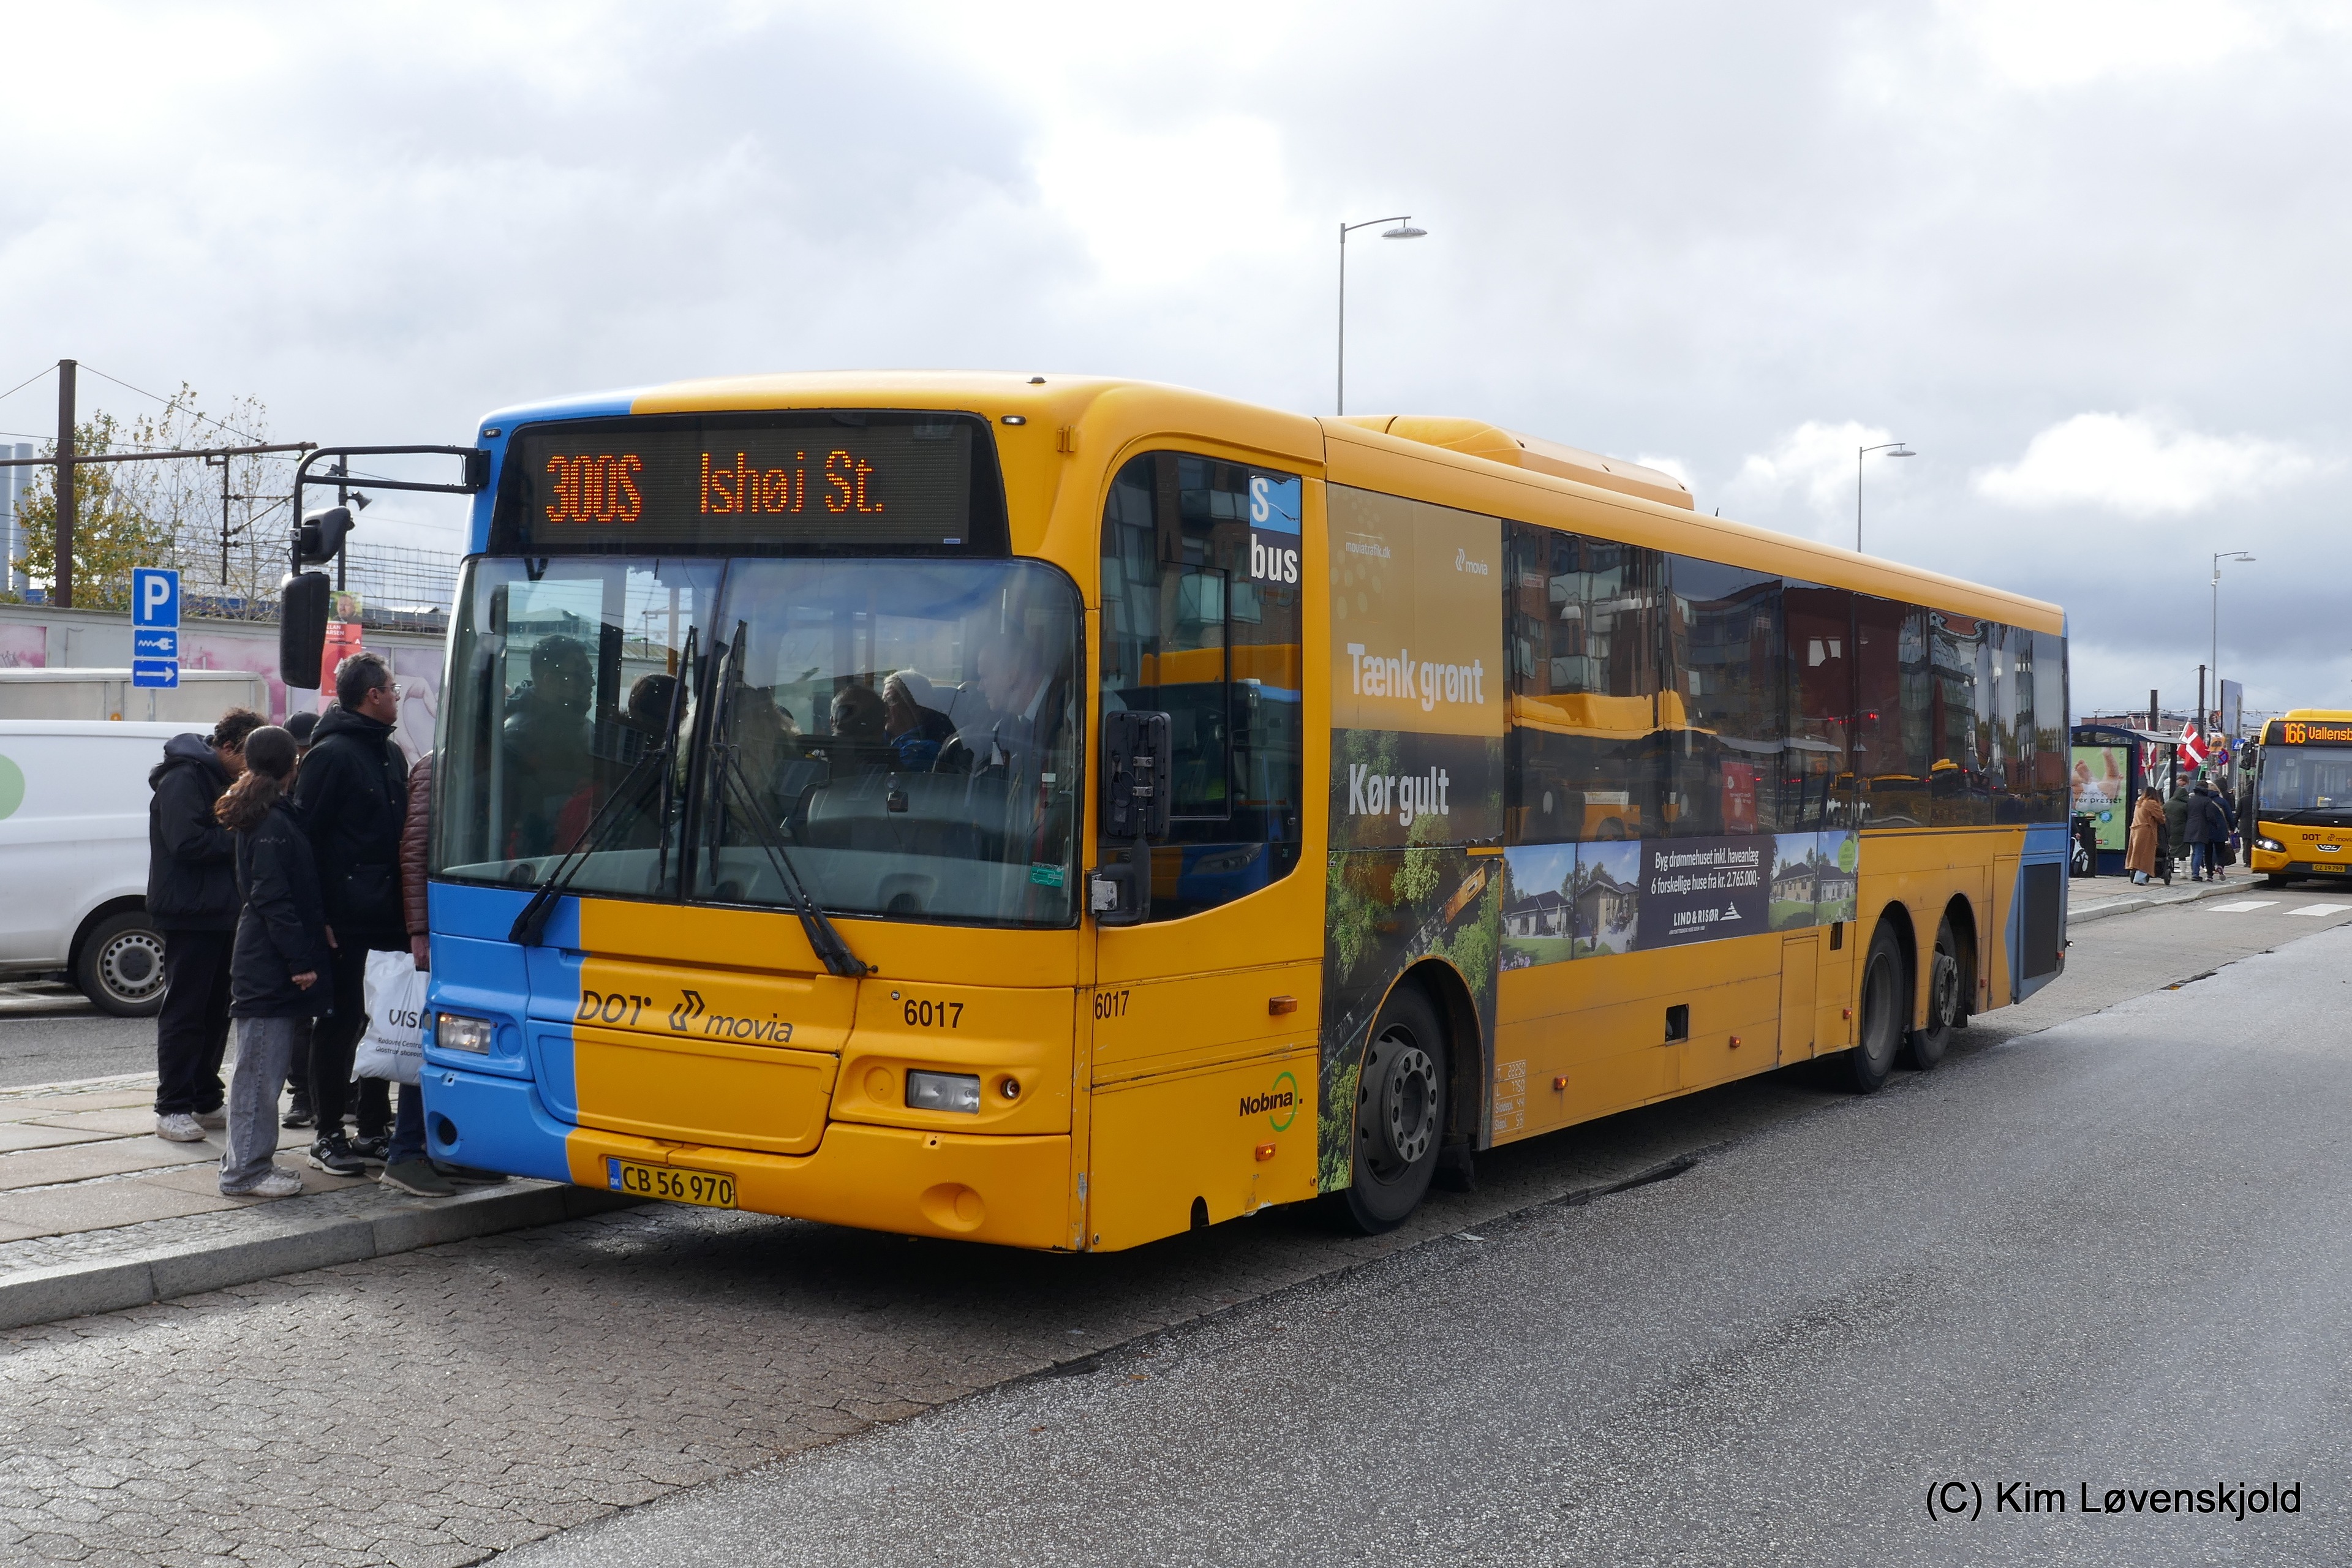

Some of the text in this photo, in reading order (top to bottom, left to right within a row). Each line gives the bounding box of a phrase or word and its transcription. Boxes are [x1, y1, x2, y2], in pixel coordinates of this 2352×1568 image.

[546, 450, 884, 522] 300S Ishøj St.
[1251, 477, 1269, 522] S
[1251, 533, 1298, 584] bus
[1346, 541, 1391, 559] moviatrafik.dk
[1466, 559, 1488, 575] movia
[144, 575, 170, 620] P
[1348, 643, 1483, 712] Tænk grønt
[2283, 723, 2306, 744] 166
[1349, 763, 1449, 826] Kør gult
[1655, 846, 1759, 872] Byg drømmehuset inkl. haveanlæg
[1651, 878, 1656, 895] 6
[1657, 875, 1691, 895] forskellige
[1692, 874, 1707, 891] huse
[1708, 873, 1716, 889] fra
[1727, 870, 1760, 888] 2.765.000,-
[389, 1009, 423, 1029] VISI
[904, 999, 964, 1028] 6017
[1095, 990, 1129, 1020] 6017
[704, 1012, 794, 1043] movia
[1240, 1092, 1293, 1117] Nobina
[610, 1177, 619, 1186] DK
[623, 1166, 732, 1205] CB 56 970
